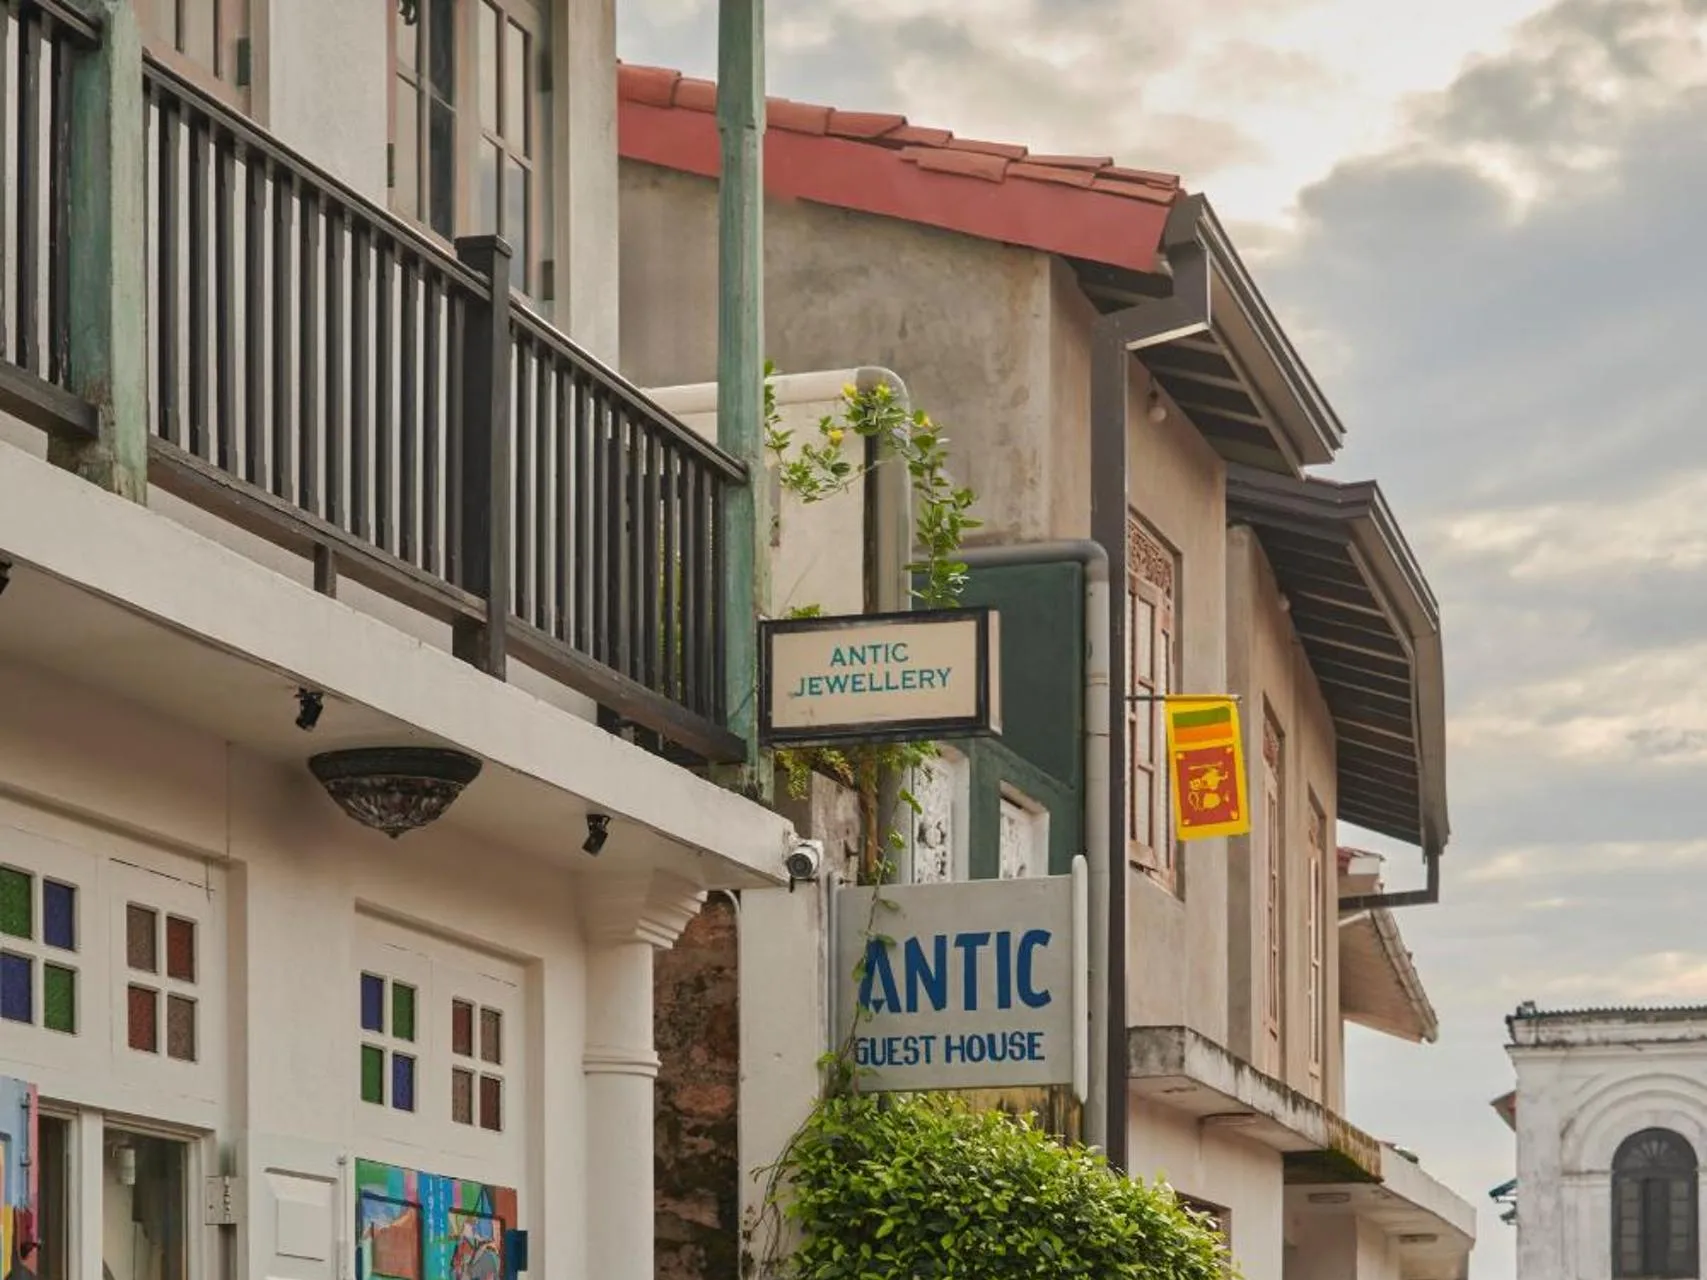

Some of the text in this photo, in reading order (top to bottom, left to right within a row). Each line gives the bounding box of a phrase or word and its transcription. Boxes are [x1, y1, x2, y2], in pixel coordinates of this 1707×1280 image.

[830, 643, 909, 667] ANTIC
[793, 667, 952, 698] JEWELLERY
[859, 929, 1053, 1013] ANTIC
[854, 1032, 1046, 1067] GUEST HOUSE
